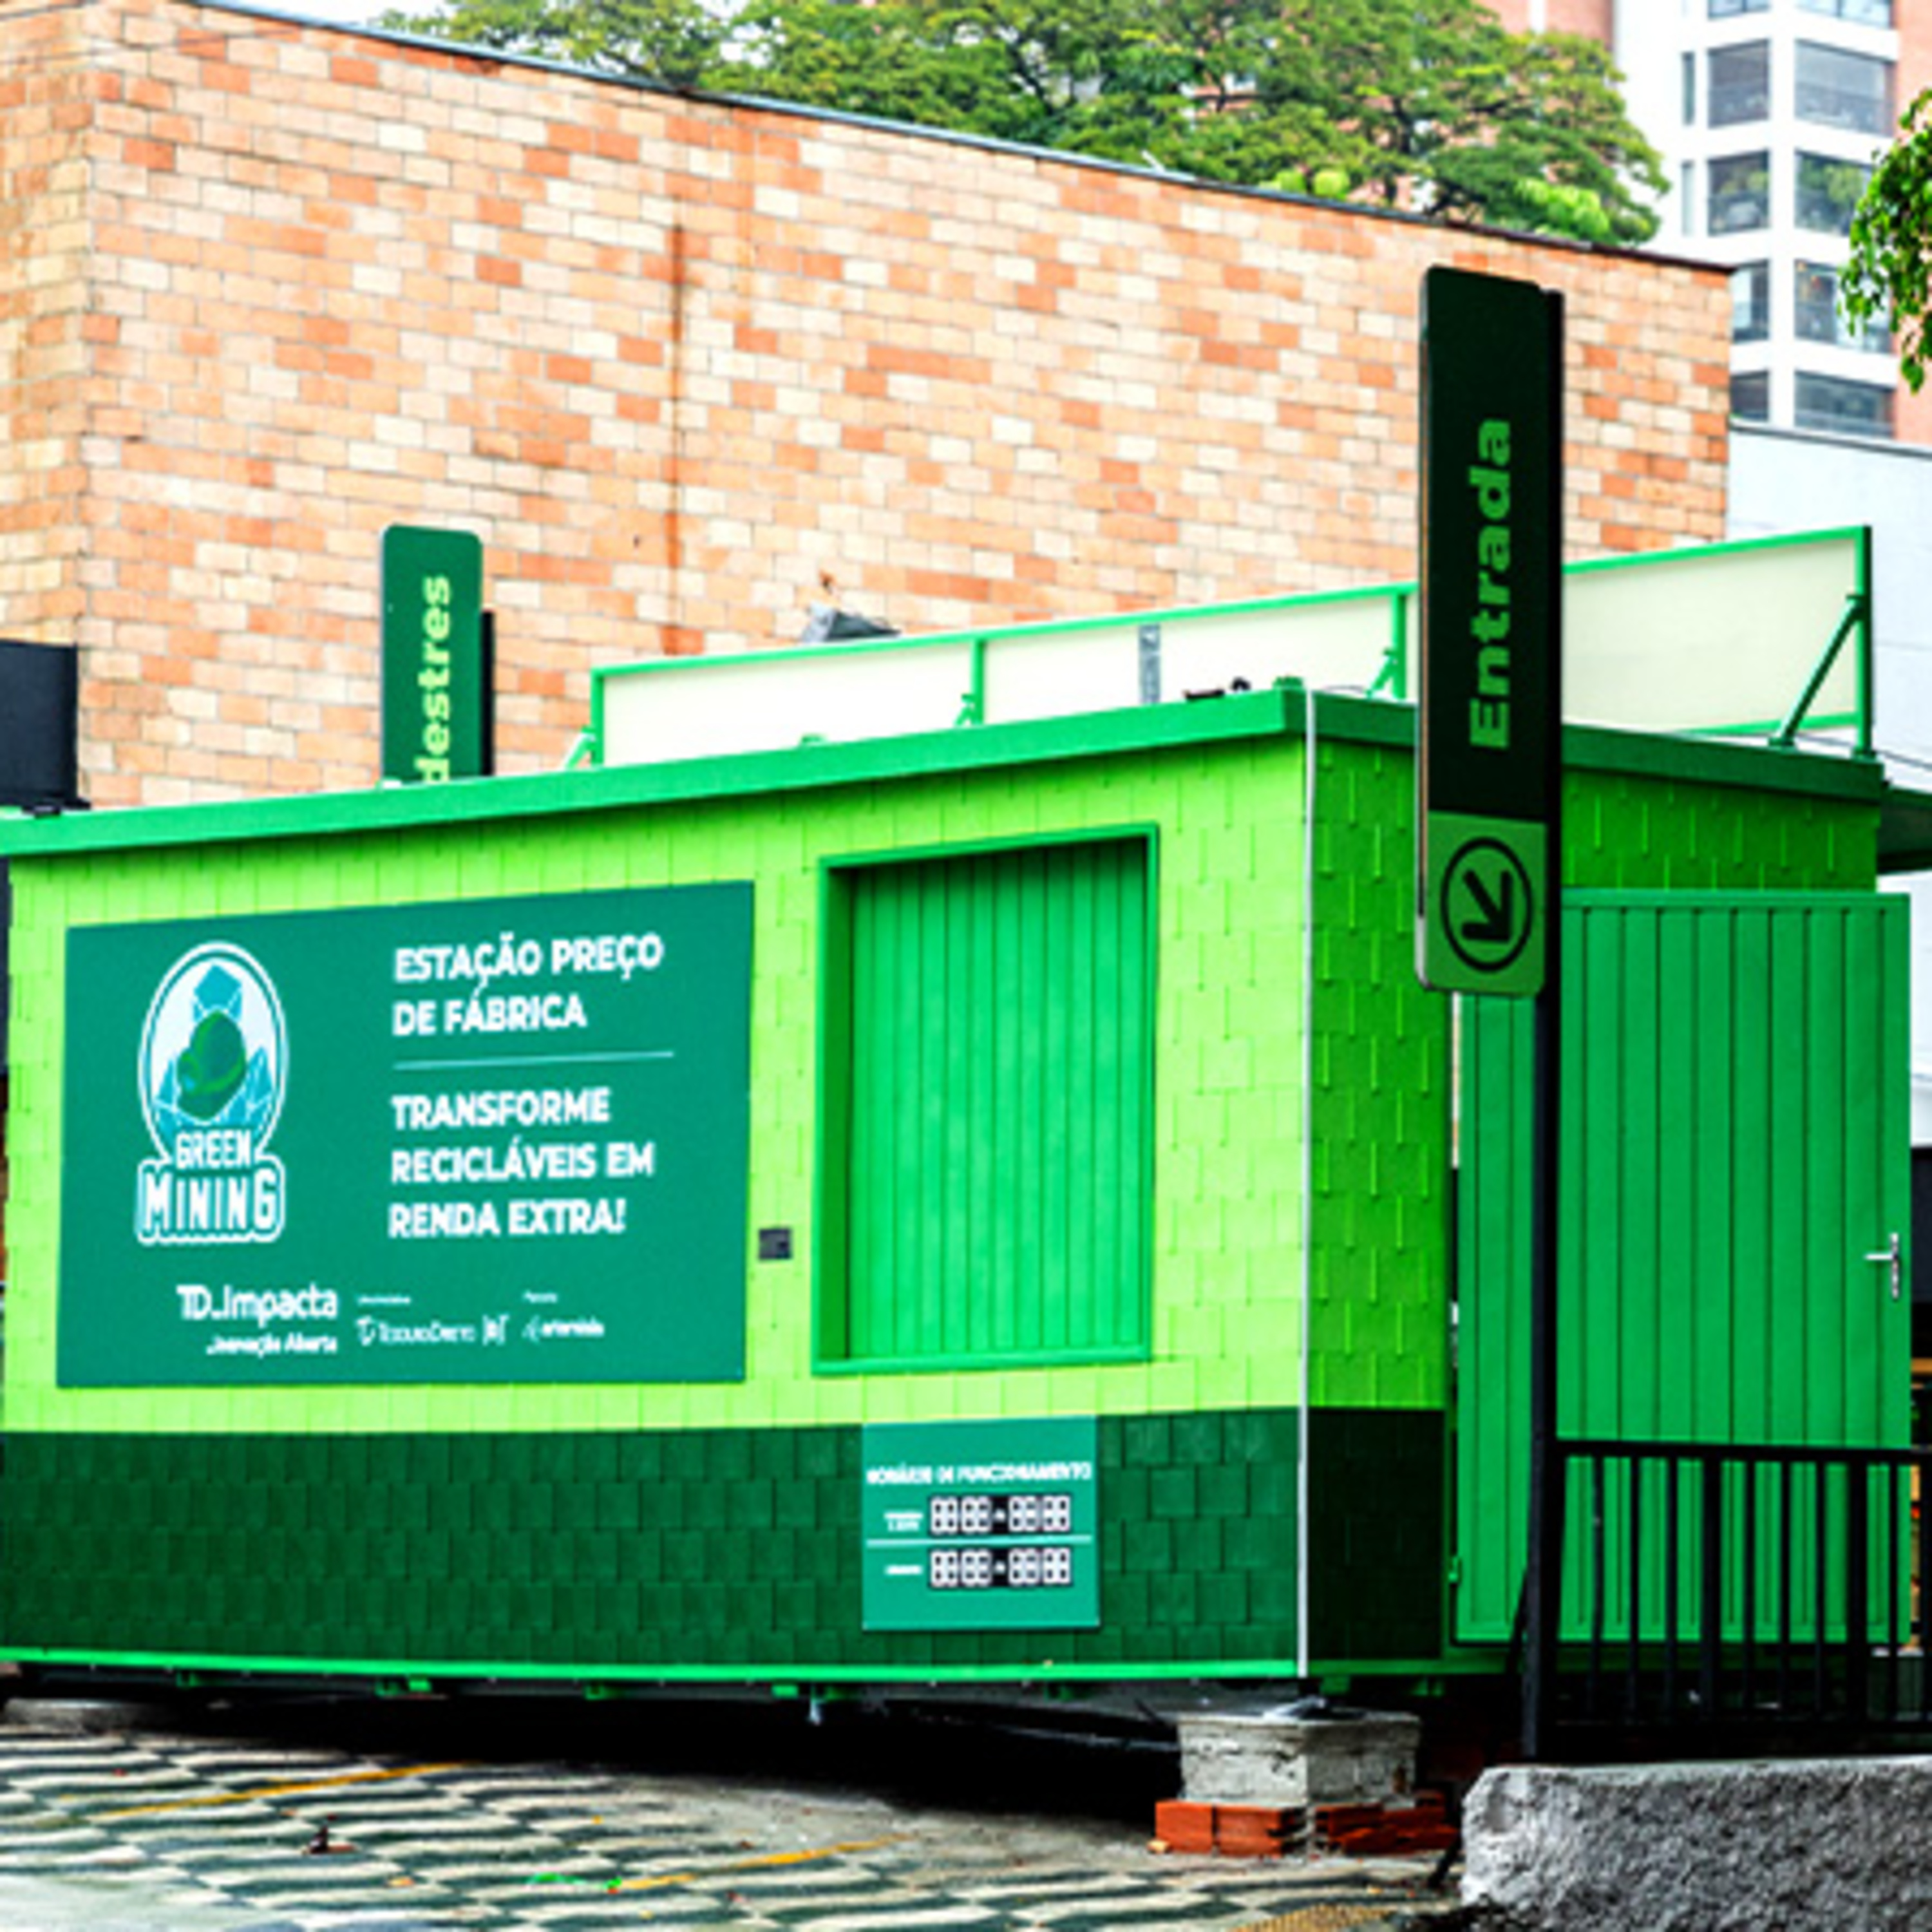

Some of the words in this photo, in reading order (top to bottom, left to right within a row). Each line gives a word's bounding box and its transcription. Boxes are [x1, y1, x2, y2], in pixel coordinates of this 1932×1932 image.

[1468, 418, 1511, 749] Entrada
[394, 931, 541, 988] ESTAÇÃO
[551, 932, 664, 981] PREÇO
[393, 1000, 437, 1036] DE
[444, 985, 587, 1034] FÁBRICA
[391, 1086, 611, 1131] TRANSFORME
[176, 1130, 251, 1170] GREEN
[391, 1133, 596, 1184] RECICLÁVEIS
[605, 1141, 655, 1178] EM
[144, 1167, 277, 1231] MINING
[388, 1200, 500, 1238] RENDA
[507, 1197, 626, 1235] EXTRA!
